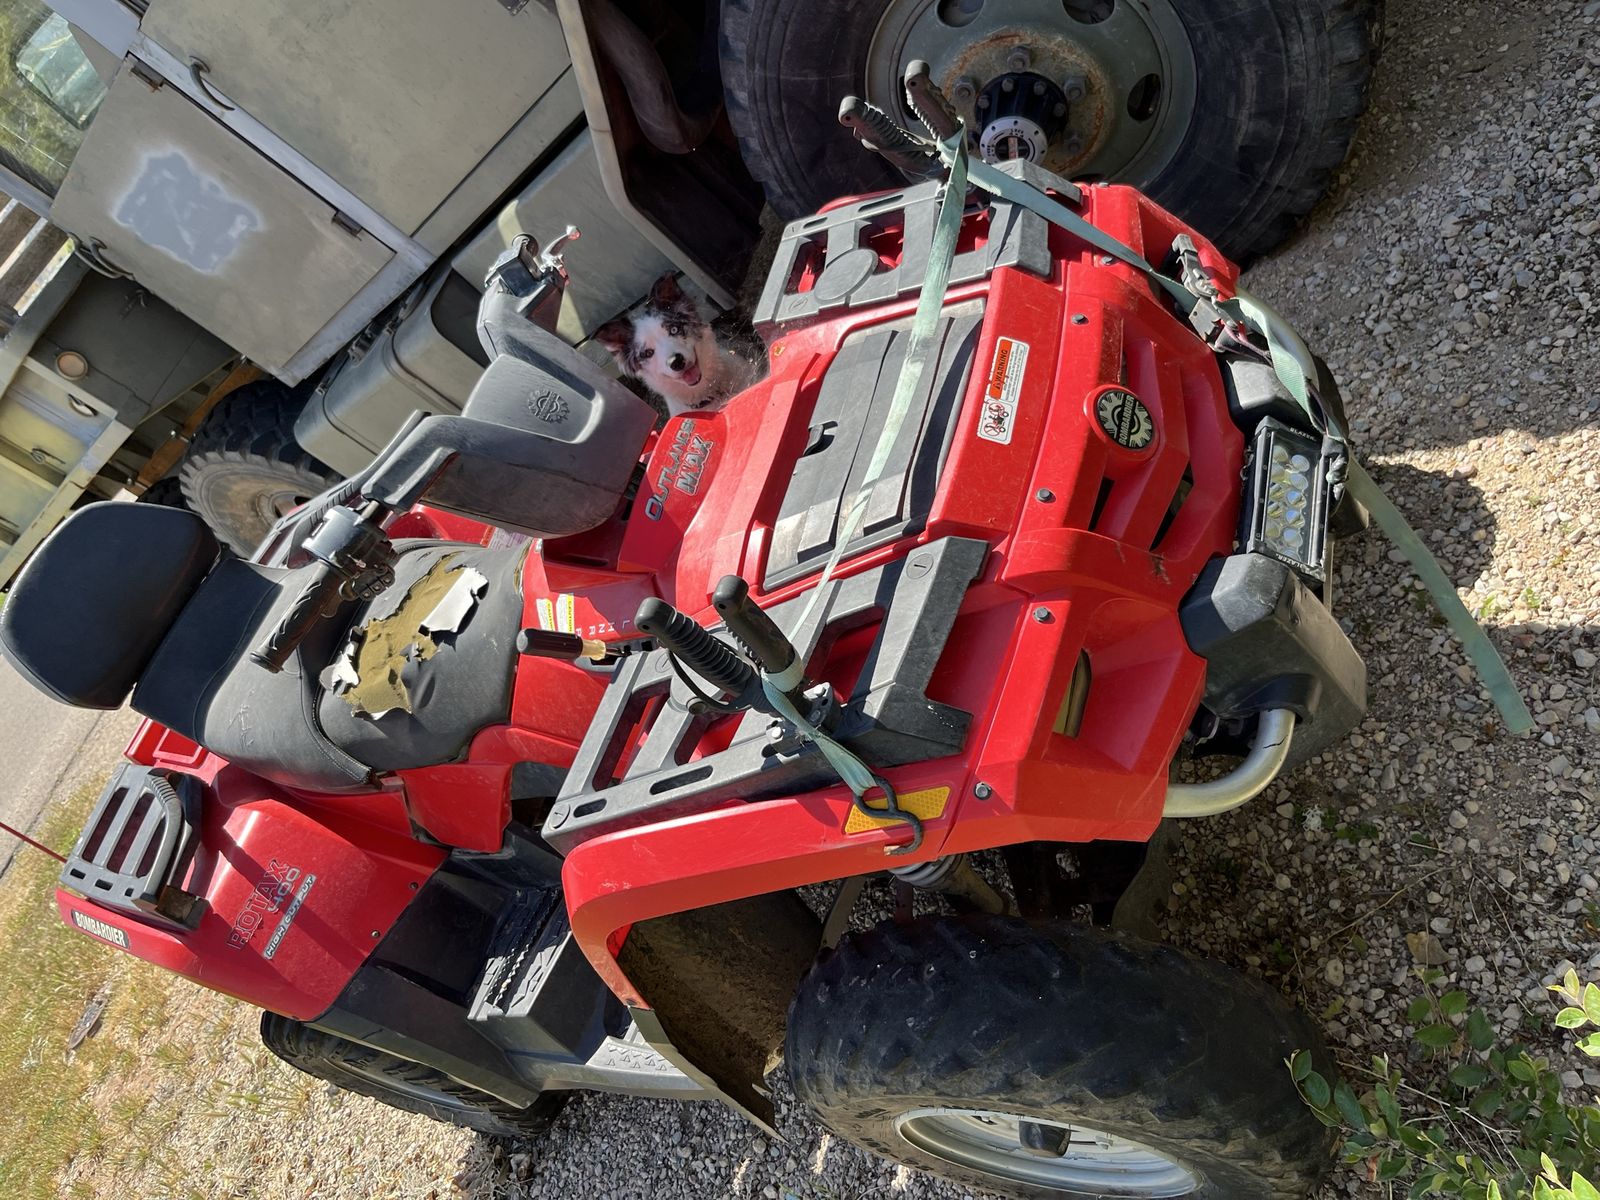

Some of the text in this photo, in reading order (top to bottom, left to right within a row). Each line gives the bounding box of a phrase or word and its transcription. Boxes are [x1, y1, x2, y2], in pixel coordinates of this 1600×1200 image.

[996, 349, 1009, 381] WARNING
[1118, 395, 1135, 446] BOMBARDIER
[675, 434, 713, 496] MAX
[225, 859, 290, 950] ROTAX
[267, 867, 301, 912] 400
[74, 911, 127, 948] BOMBARDIER
[266, 875, 314, 957] HIGH OUTPUT
